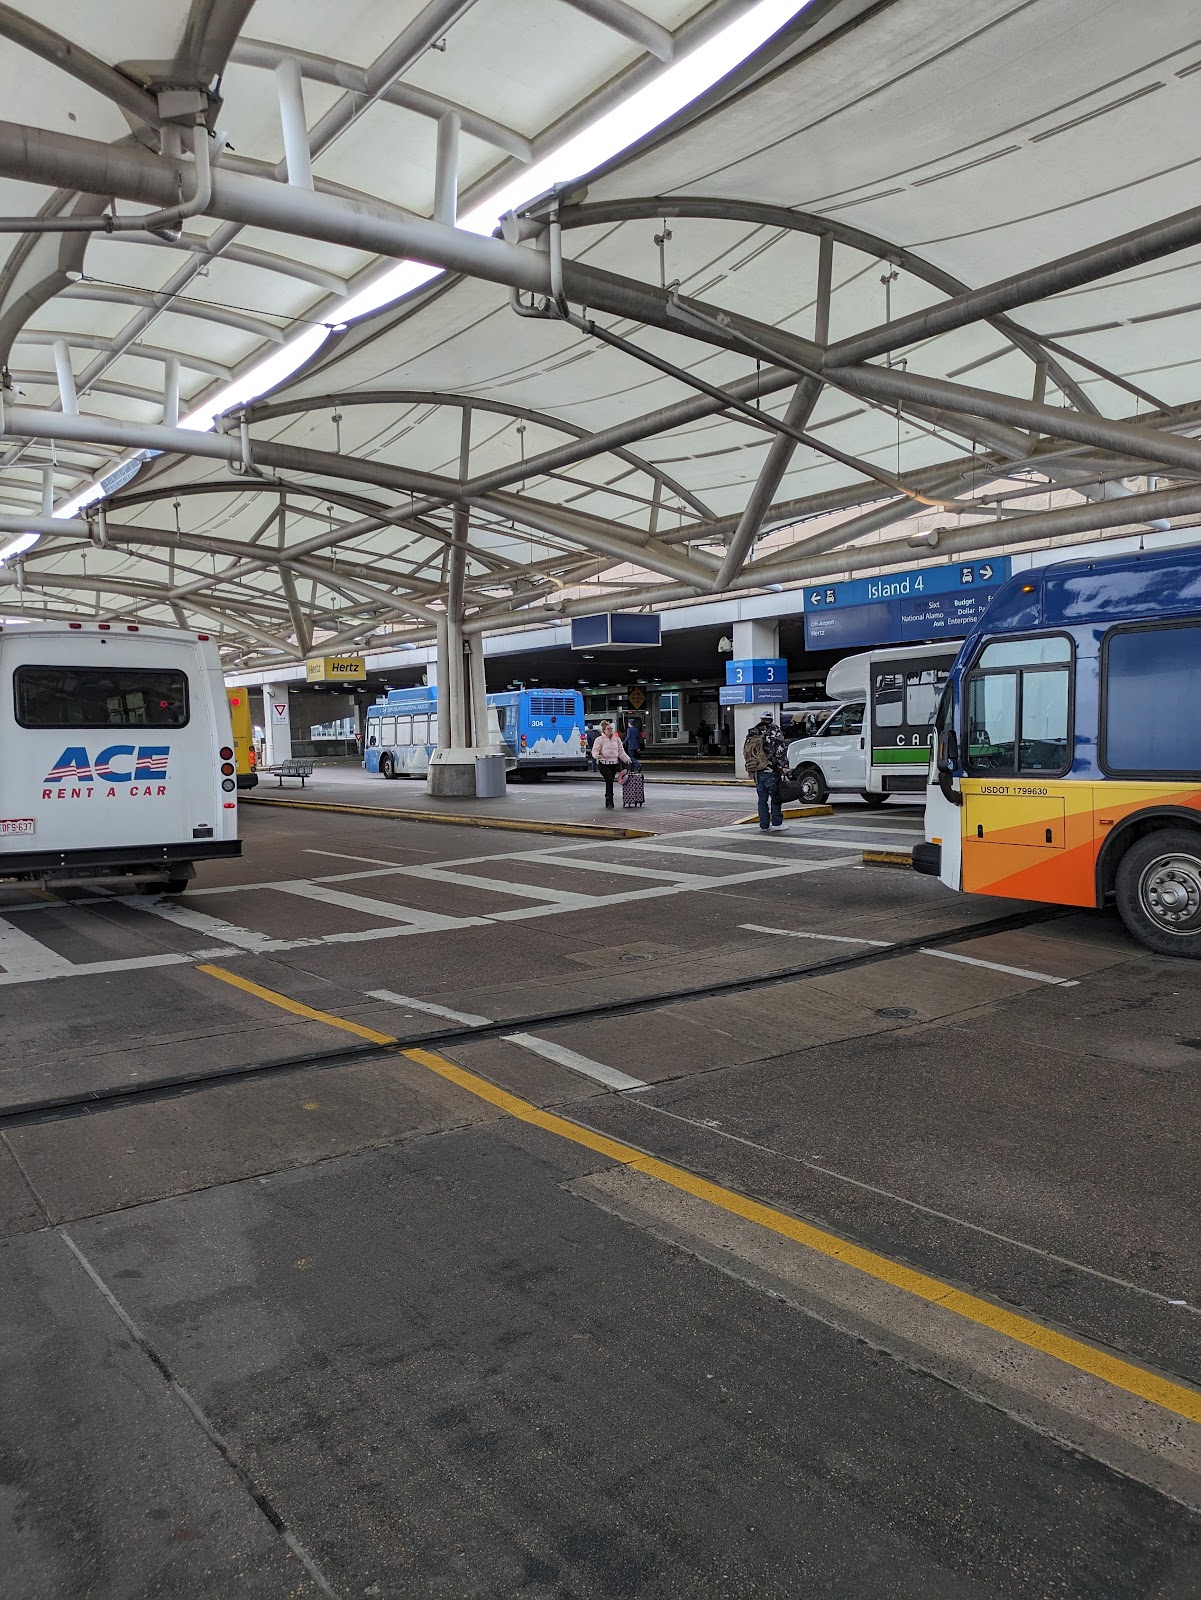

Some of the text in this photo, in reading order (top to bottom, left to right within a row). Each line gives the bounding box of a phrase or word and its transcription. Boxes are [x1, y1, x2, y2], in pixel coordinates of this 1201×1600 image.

[868, 575, 925, 599] Island 4
[928, 601, 940, 610] Sixt
[954, 598, 976, 607] Budget
[957, 607, 976, 616] Dollar
[901, 611, 944, 623] National Alamo
[947, 615, 978, 625] Enterprise
[932, 620, 945, 628] Avis
[810, 629, 825, 637] Hertz
[331, 662, 360, 672] Hertz
[736, 668, 743, 683] 3
[766, 666, 774, 682] 3
[43, 744, 171, 783] ACE
[42, 785, 167, 800] RENT A CAR
[980, 786, 1048, 796] USDOT 1799630
